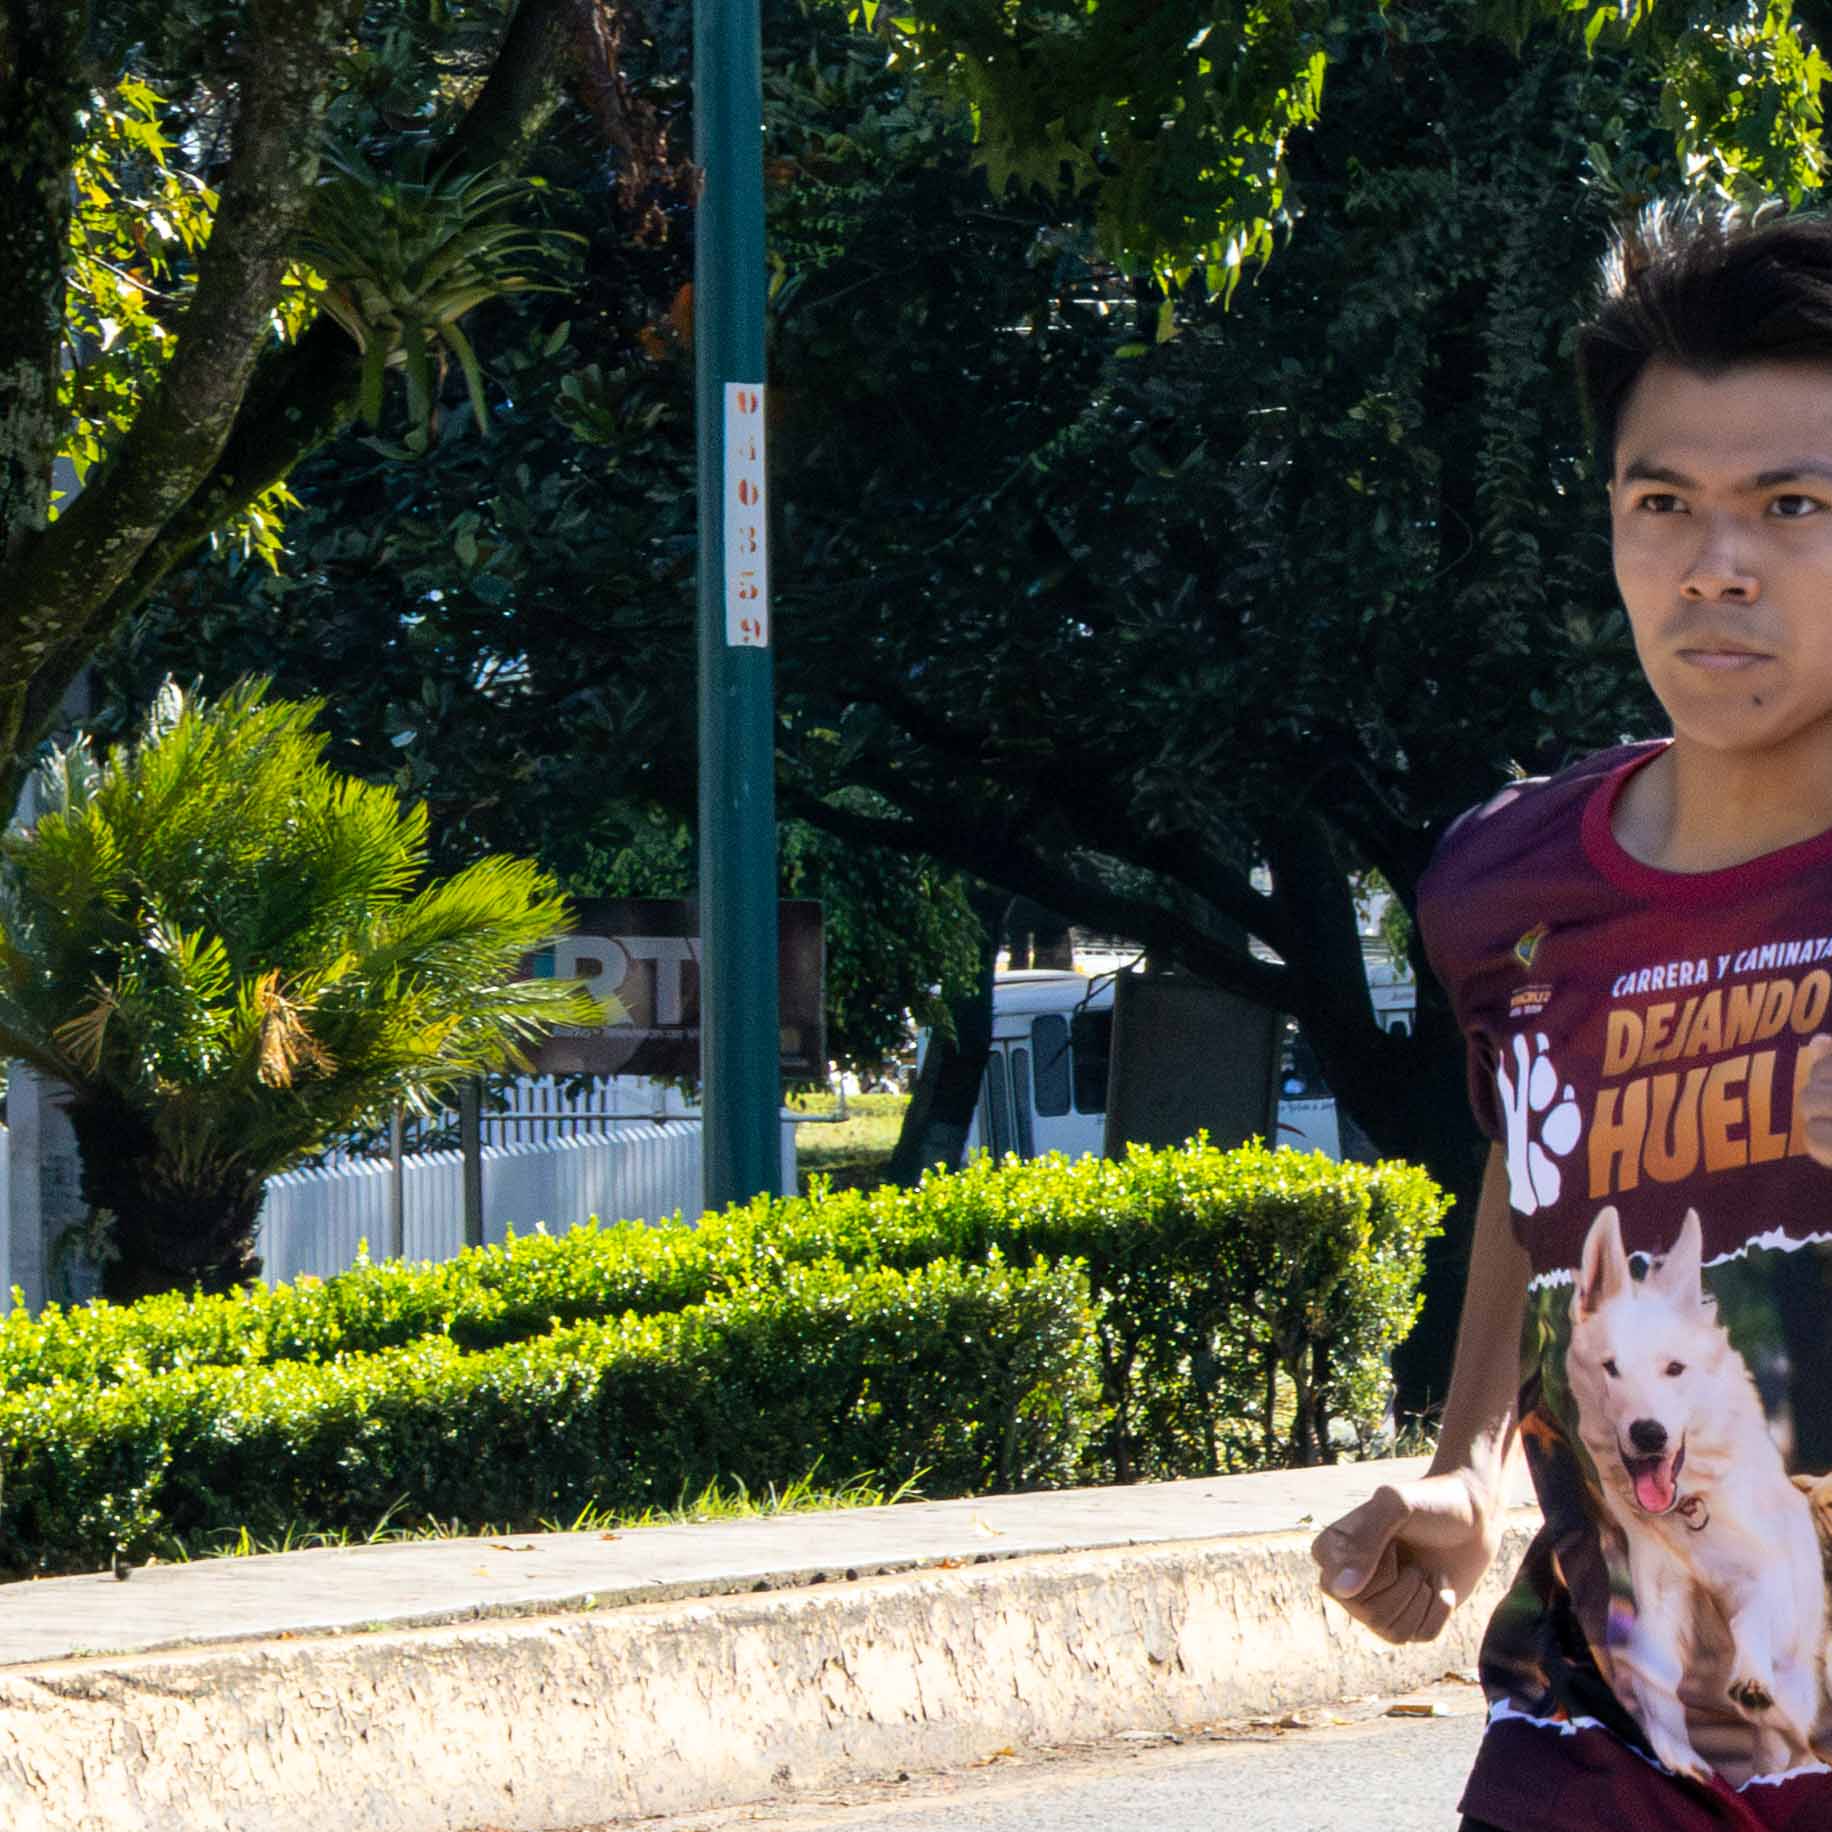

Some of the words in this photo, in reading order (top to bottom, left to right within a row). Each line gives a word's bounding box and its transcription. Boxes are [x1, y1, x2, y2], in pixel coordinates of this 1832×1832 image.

[552, 935, 702, 1026] RT
[1611, 957, 1709, 998] CARRERA
[1717, 954, 1731, 980] Y
[1602, 968, 1832, 1078] DEJANDO
